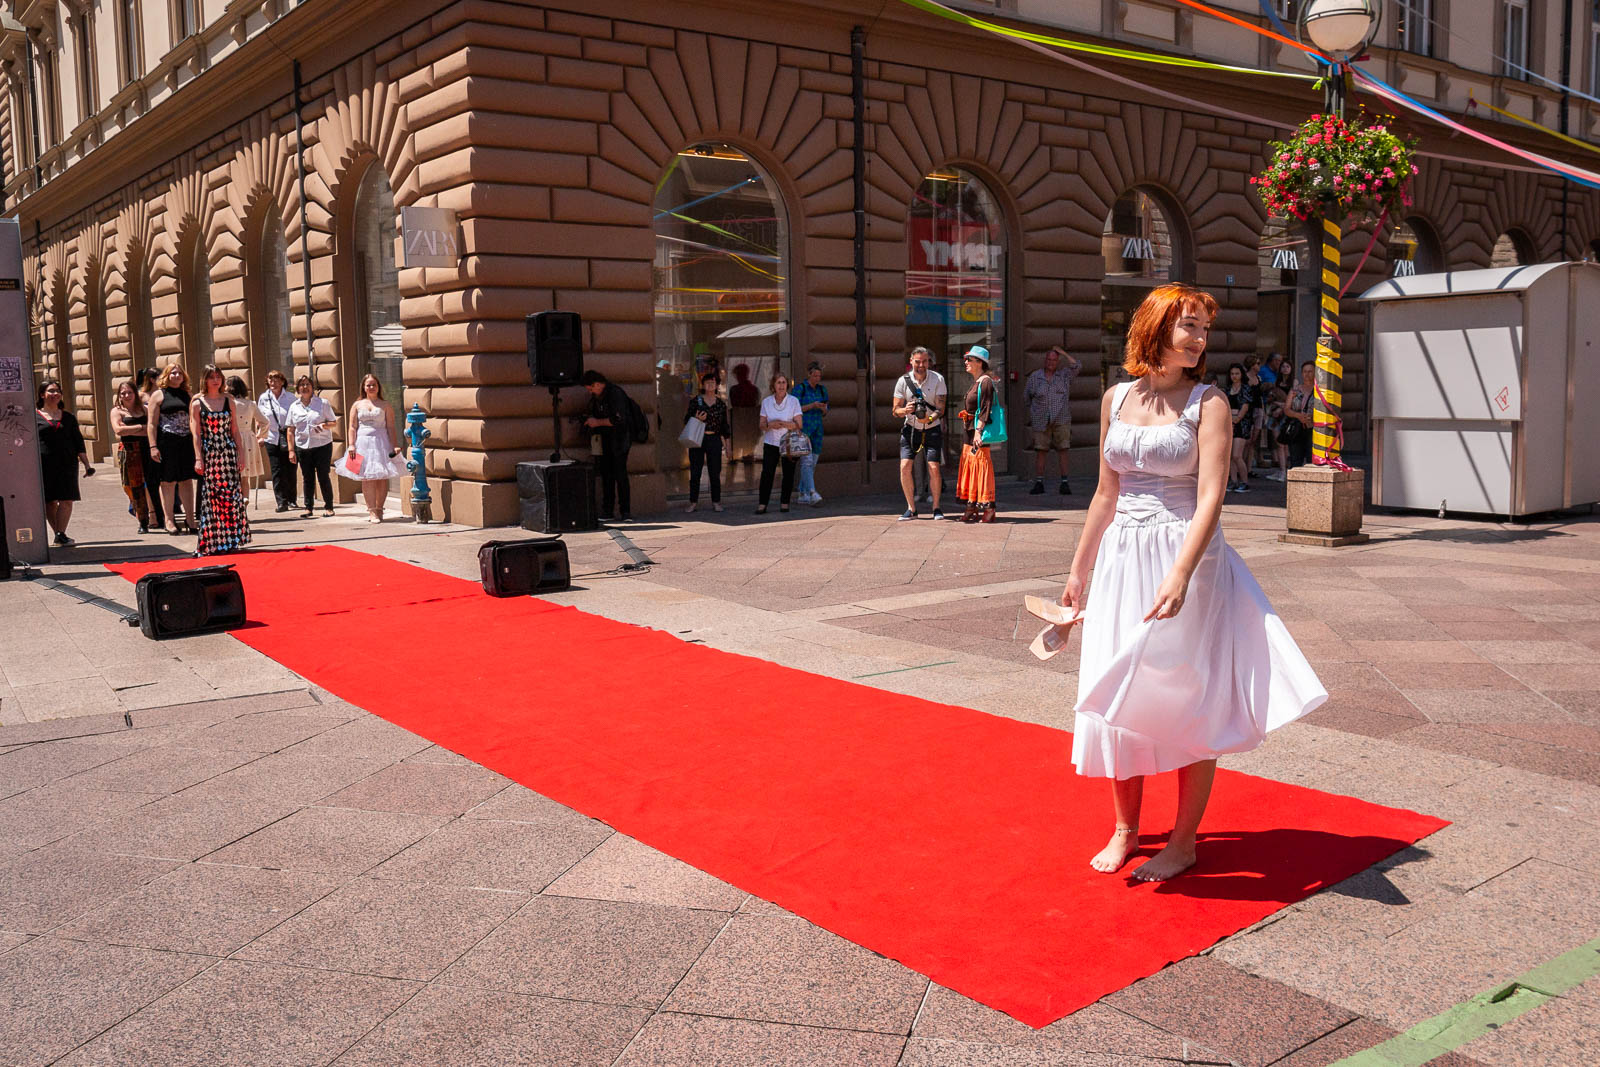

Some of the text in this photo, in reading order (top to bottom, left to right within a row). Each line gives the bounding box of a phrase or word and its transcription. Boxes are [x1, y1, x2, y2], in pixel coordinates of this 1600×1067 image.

[406, 230, 458, 256] ZARA
[1122, 237, 1154, 260] ZARA
[1272, 249, 1299, 270] ZARA
[1394, 259, 1416, 277] ZARA
